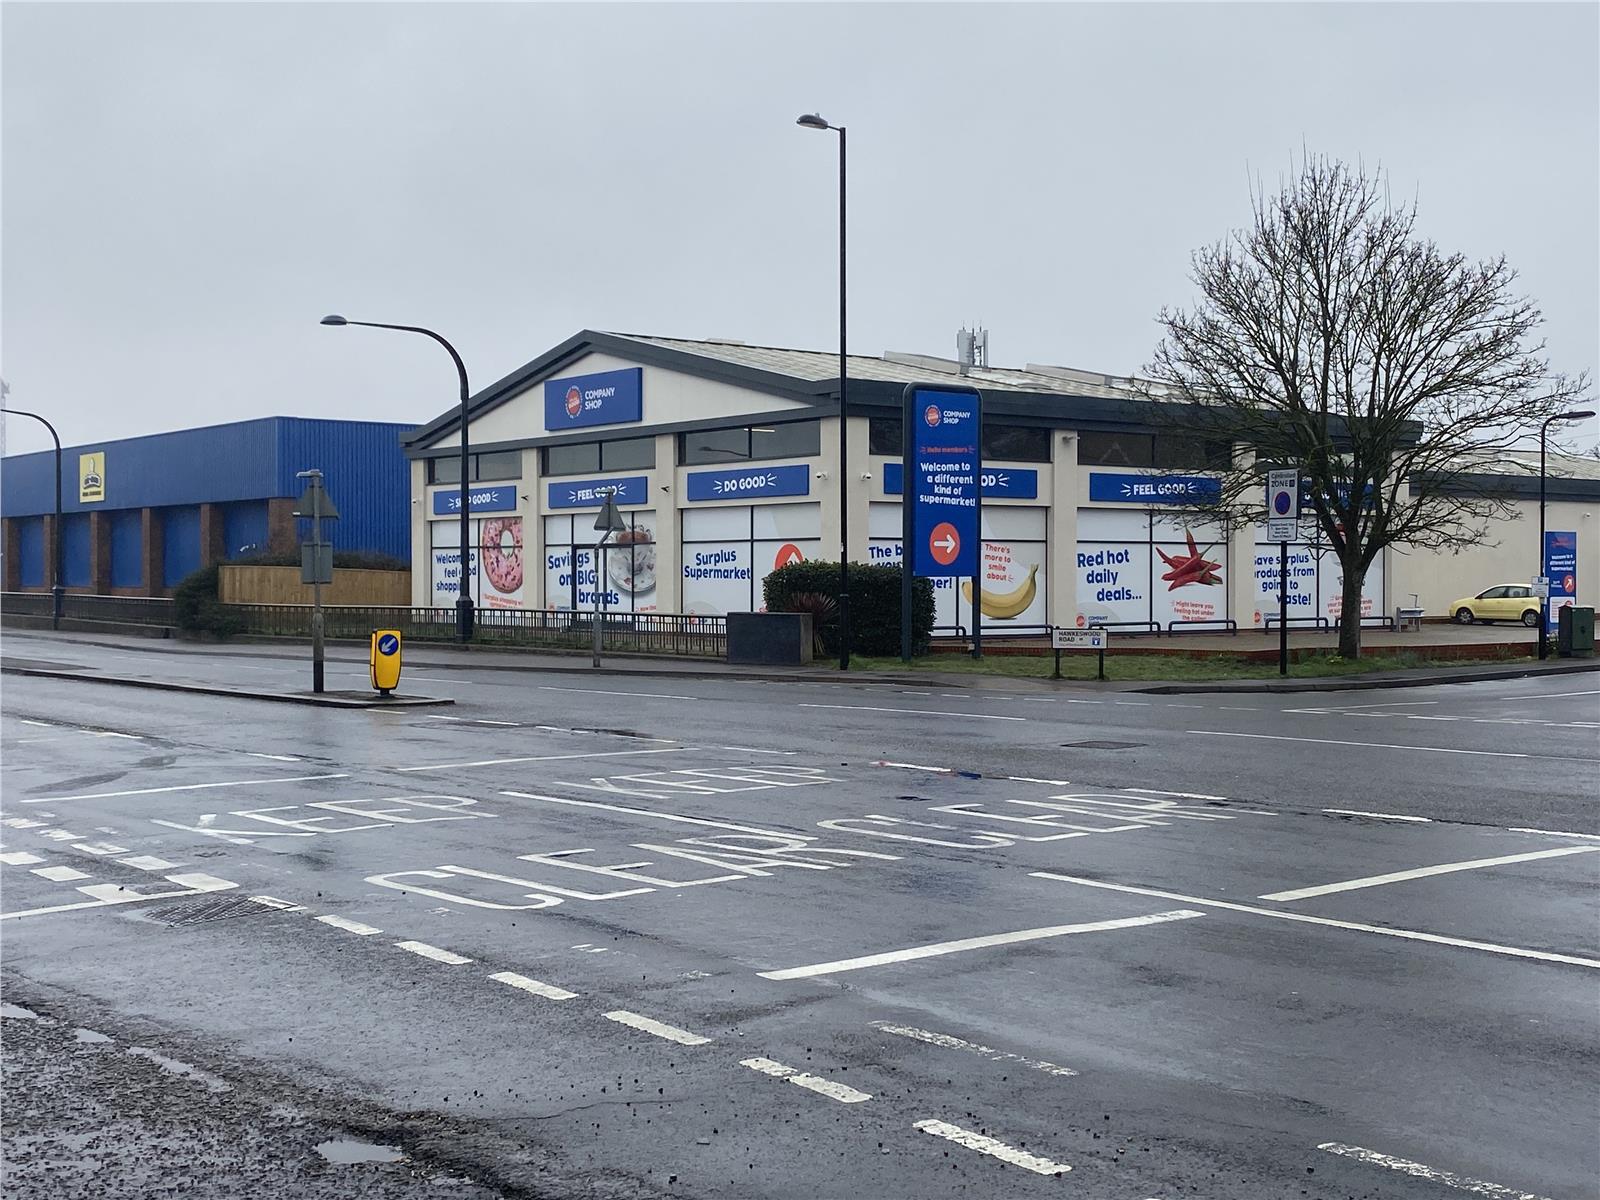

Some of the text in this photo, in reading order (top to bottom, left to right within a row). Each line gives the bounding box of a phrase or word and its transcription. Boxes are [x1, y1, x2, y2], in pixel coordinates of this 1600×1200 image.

[585, 387, 615, 400] COMPANY
[585, 400, 602, 410] SHOP
[943, 410, 971, 418] COMPANY
[920, 462, 971, 472] Welcome to
[724, 475, 766, 492] DO GOOD
[926, 473, 974, 484] a different
[980, 474, 997, 487] OD
[1271, 480, 1289, 488] ZONE
[577, 489, 594, 501] FEEL
[934, 485, 962, 495] kind of
[1133, 483, 1187, 496] FEEL GOOD
[472, 492, 491, 505] GOOD
[919, 494, 976, 507] supermarket!
[868, 546, 892, 559] The
[985, 543, 1010, 554] There's
[435, 553, 476, 564] Welcom o
[548, 551, 590, 569] Savigs
[695, 549, 737, 567] Surplus
[984, 554, 1003, 562] more
[1077, 549, 1130, 568] Red hot
[1275, 553, 1310, 566] srplus
[444, 568, 459, 578] feel
[684, 565, 752, 581] Supermarket
[988, 564, 1006, 572] smile
[1254, 566, 1315, 579] roducs from
[559, 569, 597, 586] on BIG
[986, 572, 1007, 581] about
[1086, 568, 1119, 586] daily
[436, 581, 461, 593] shoppi
[1261, 579, 1299, 593] goin to
[1096, 586, 1142, 602] deals...
[553, 765, 847, 799] KEEP
[149, 795, 500, 846] KEEP
[816, 793, 1279, 850] CLEAR
[363, 833, 905, 911] CLEAR
